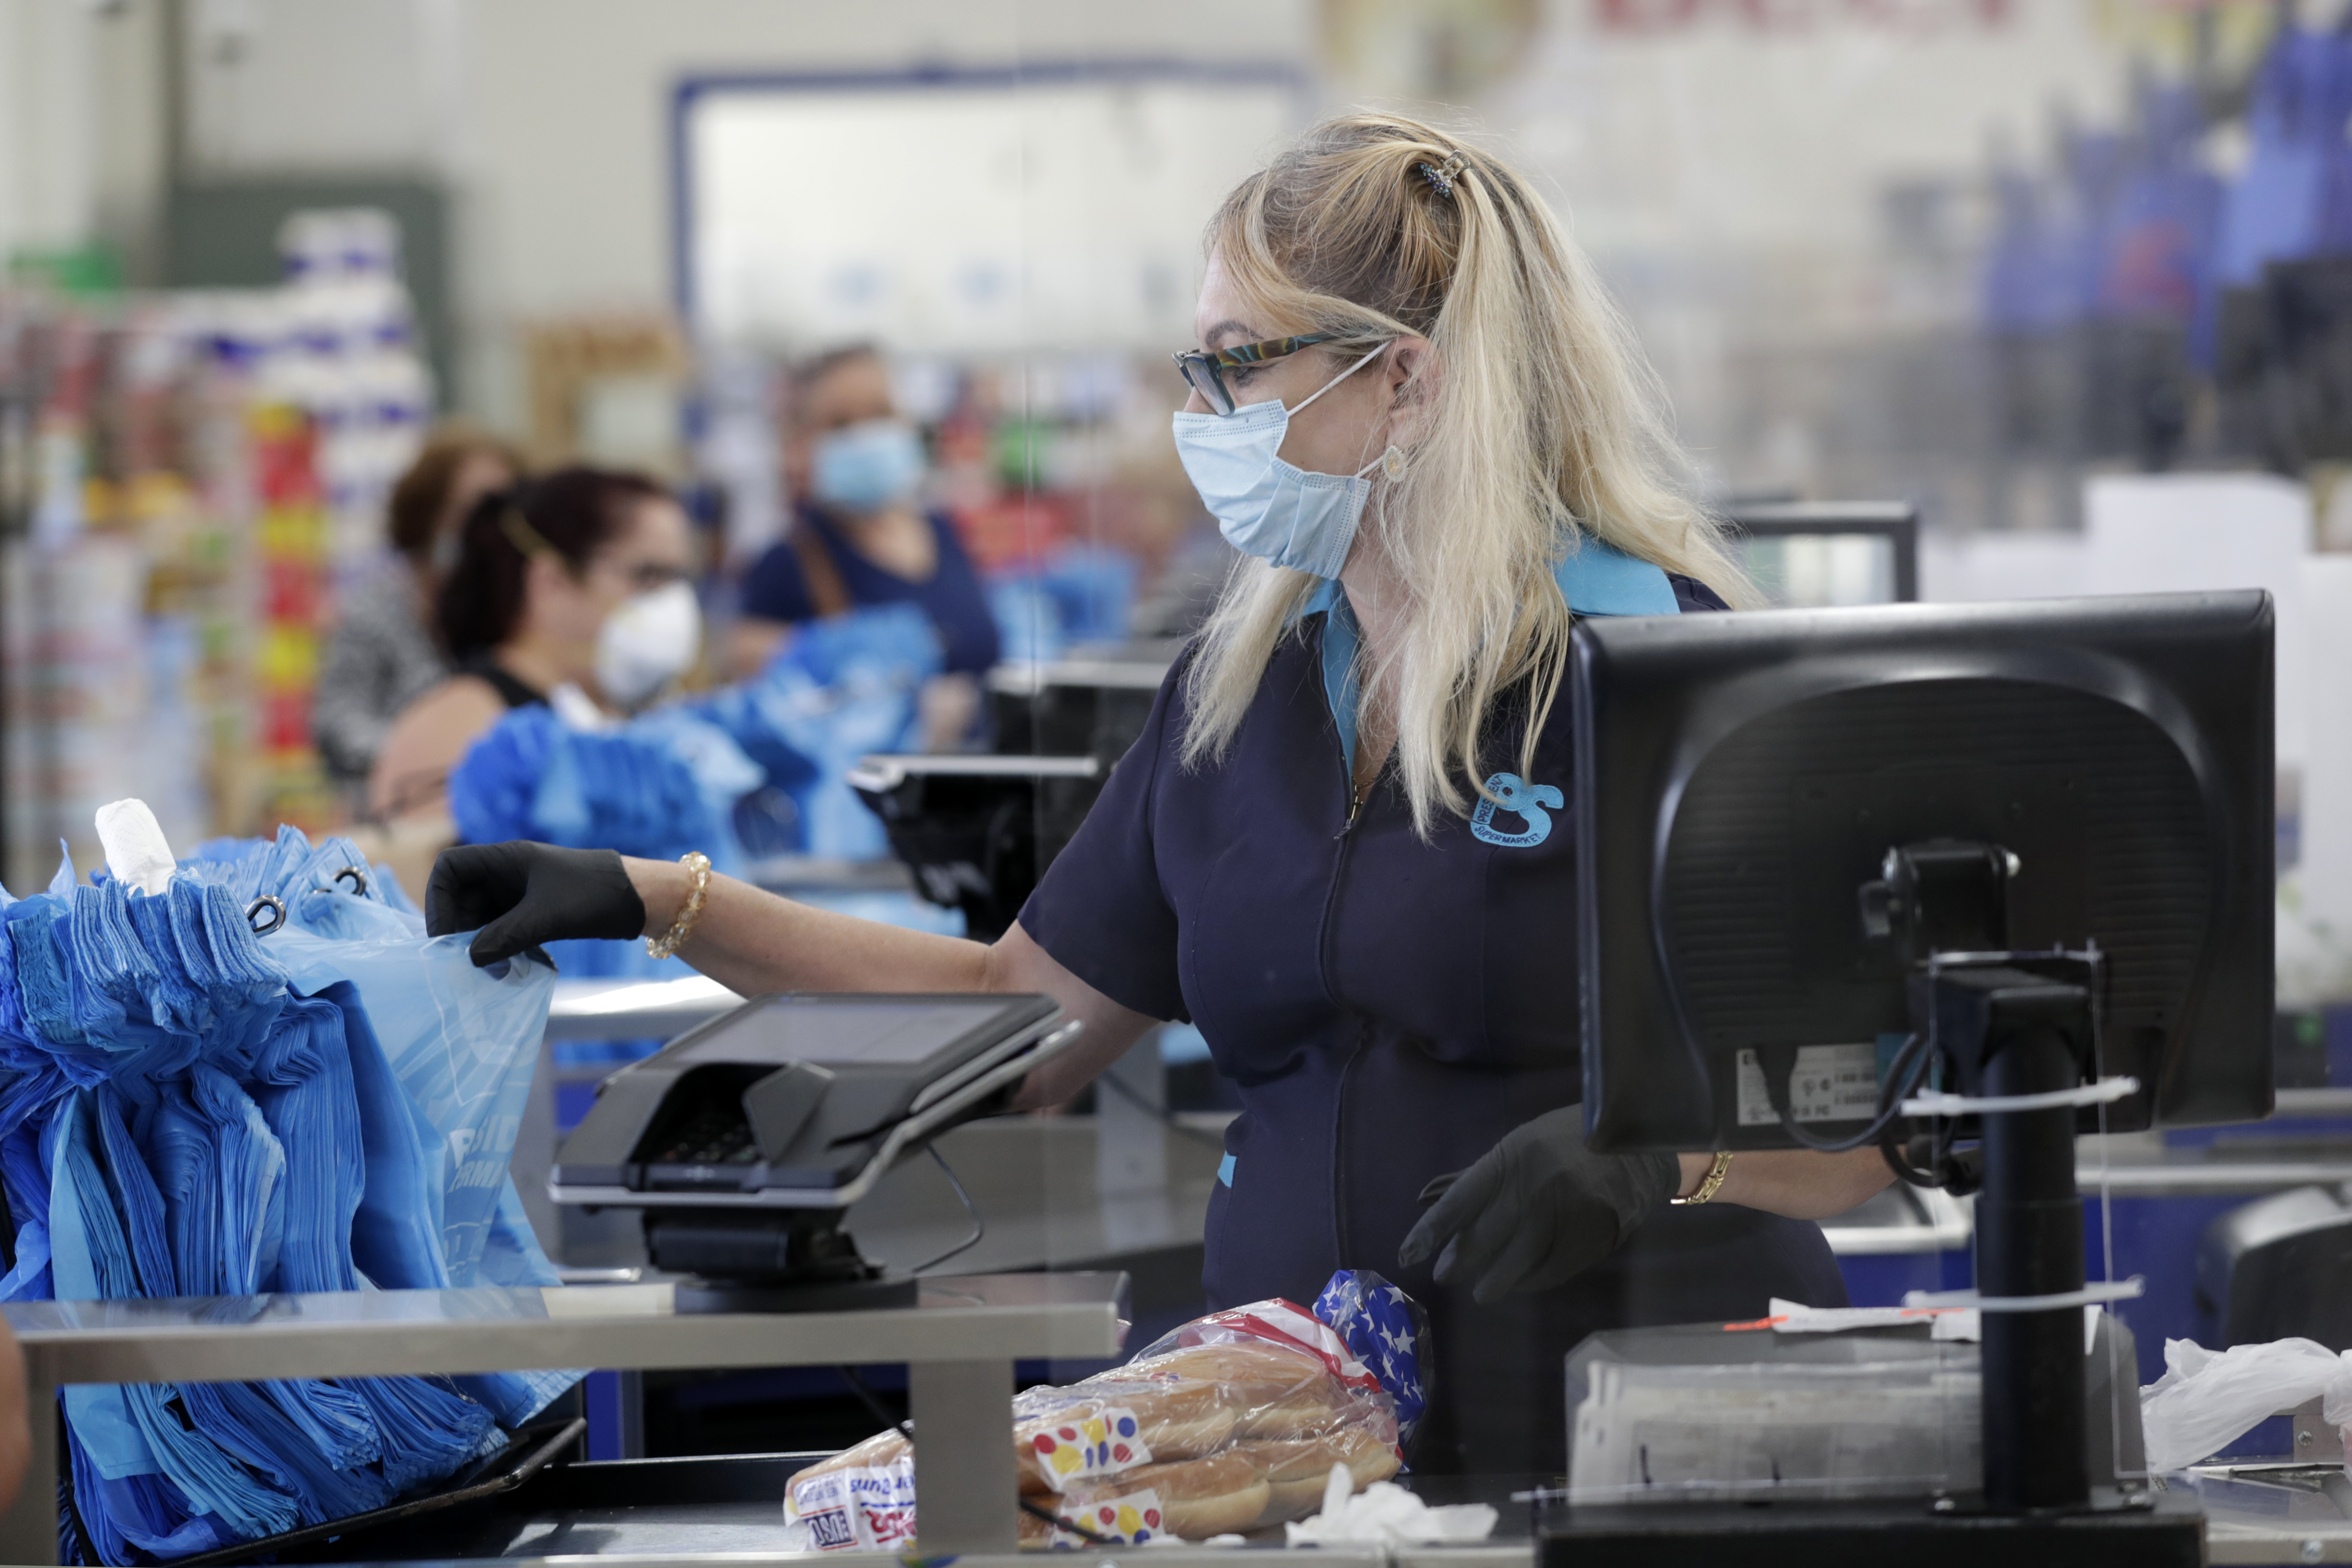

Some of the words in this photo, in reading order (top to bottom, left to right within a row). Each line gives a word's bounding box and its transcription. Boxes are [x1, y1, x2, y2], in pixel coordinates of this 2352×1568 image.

[1477, 775, 1503, 823] PRESENT
[1475, 826, 1541, 844] SUPERMARKET
[808, 1514, 845, 1544] USO
